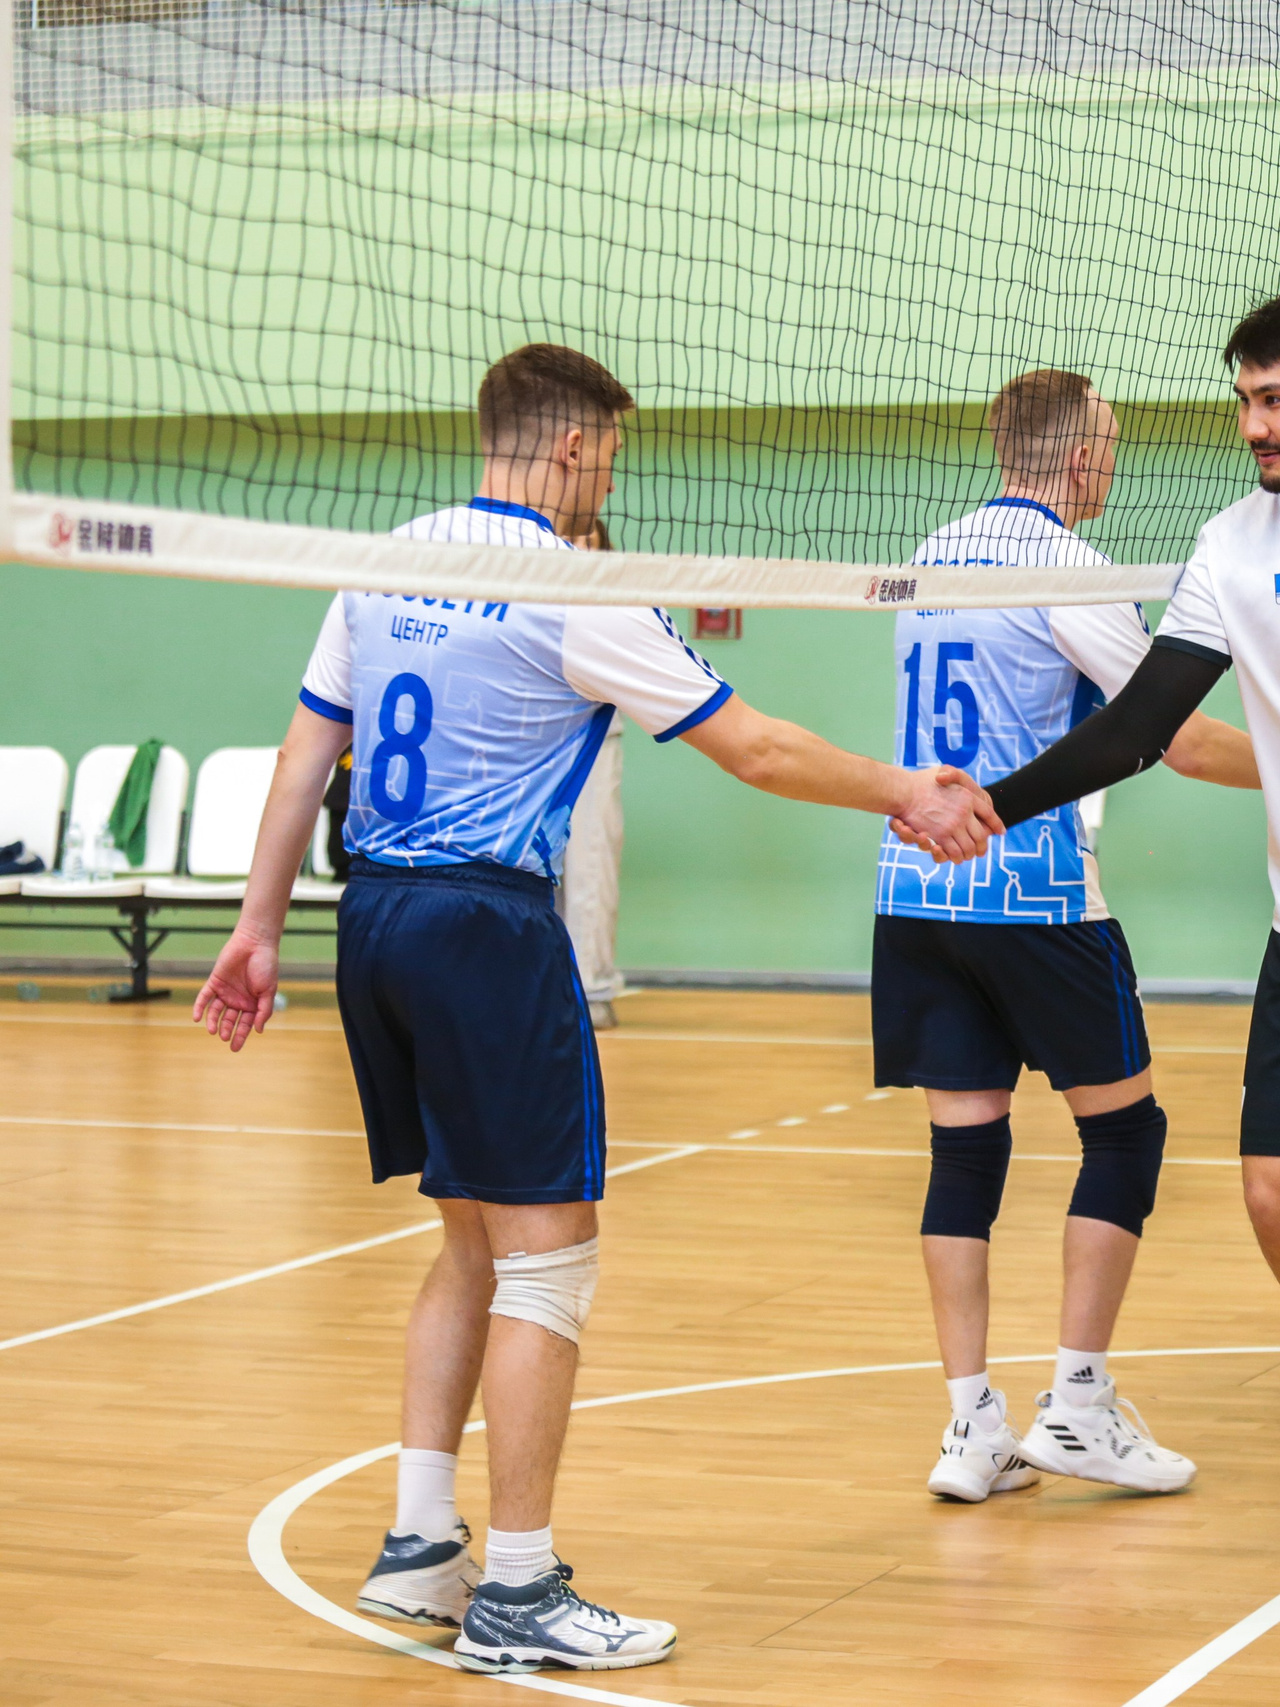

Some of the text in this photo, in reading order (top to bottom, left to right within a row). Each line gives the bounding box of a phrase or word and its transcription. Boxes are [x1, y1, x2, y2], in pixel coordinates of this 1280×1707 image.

[391, 615, 449, 645] ЦЕНТР
[369, 672, 433, 824] 8
[903, 641, 980, 769] 15
